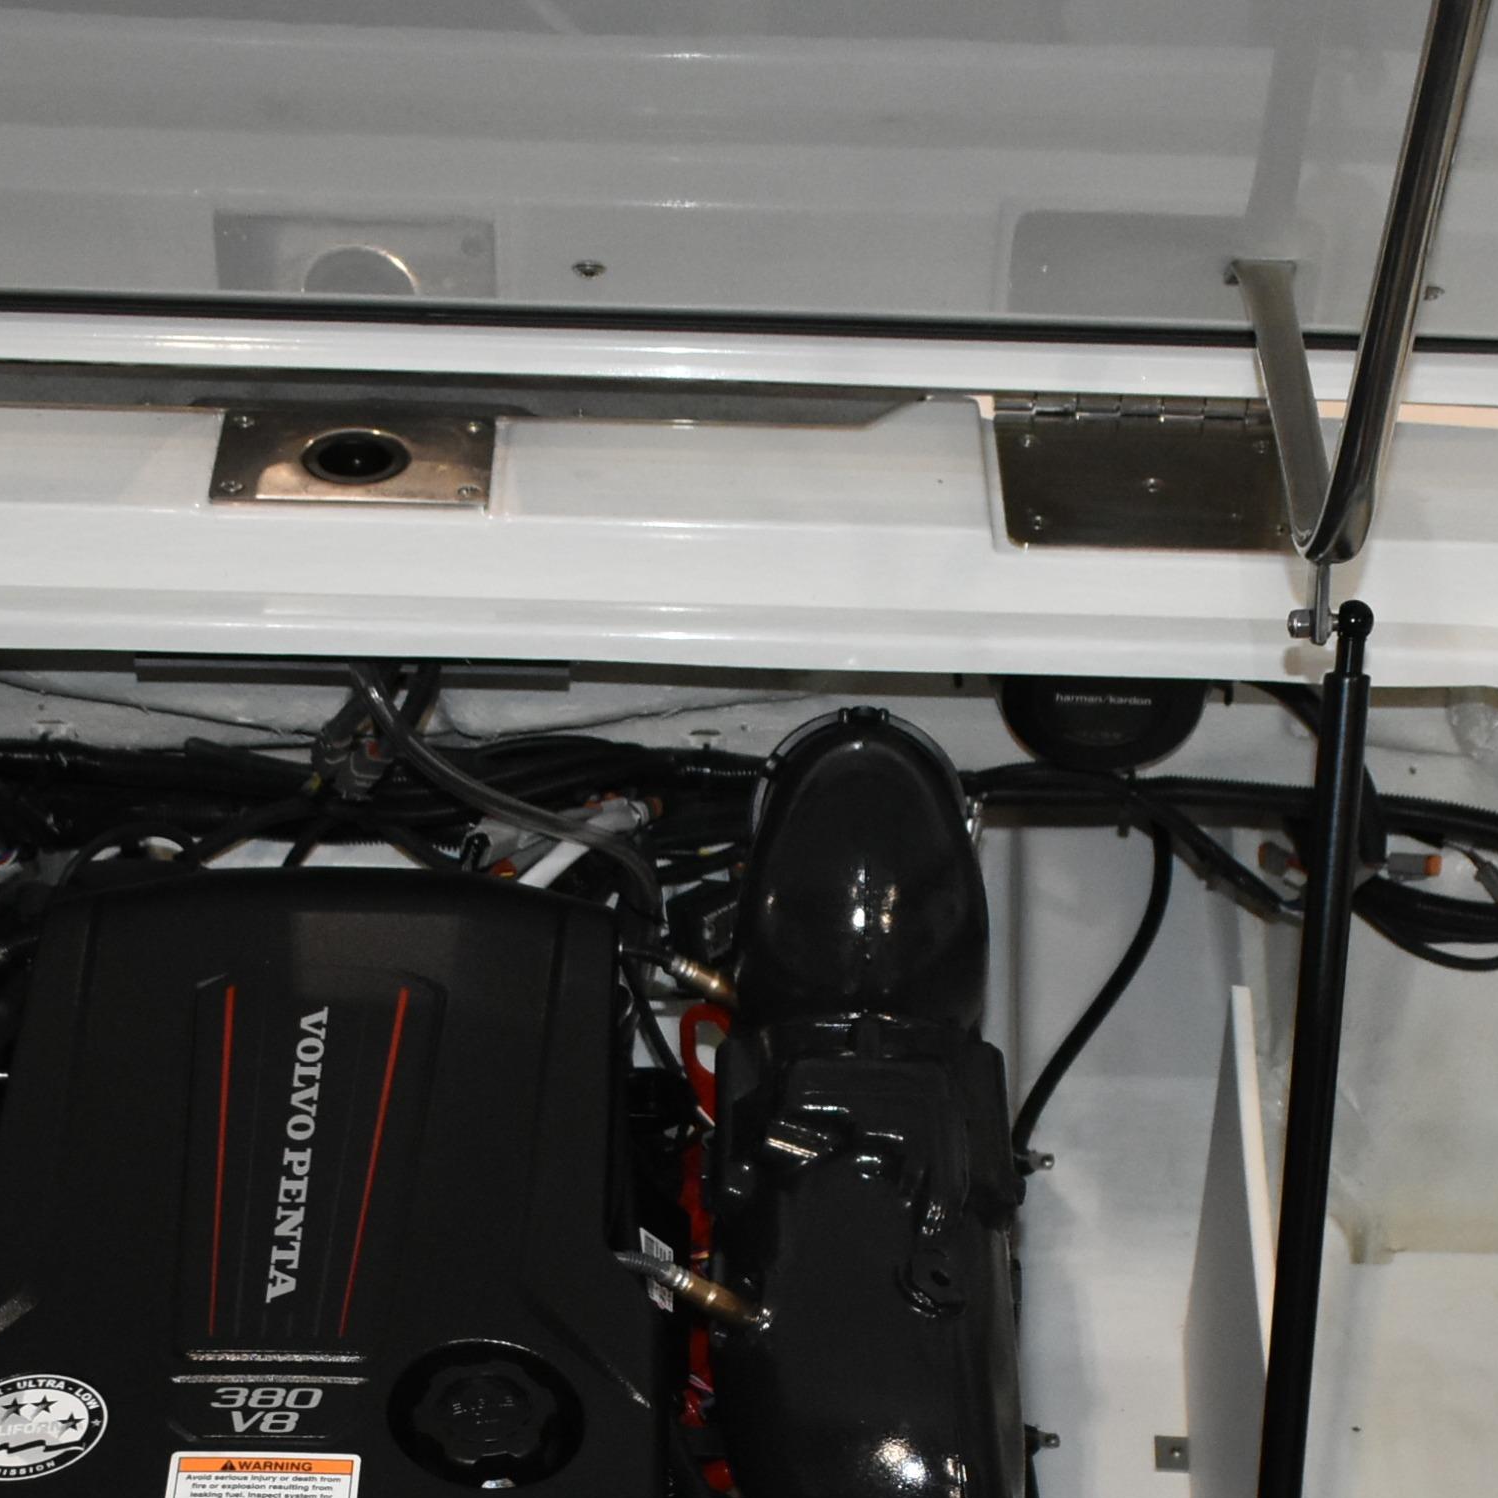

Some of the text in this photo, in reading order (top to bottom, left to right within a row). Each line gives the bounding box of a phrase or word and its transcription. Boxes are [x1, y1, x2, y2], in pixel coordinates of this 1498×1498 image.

[1054, 691, 1152, 707] harman/kardon
[265, 1006, 329, 1303] VOLVO PENTA
[16, 1378, 66, 1391] ULTRA
[73, 1386, 101, 1411] LOW
[210, 1386, 323, 1410] 380
[230, 1410, 300, 1435] V8
[238, 1460, 313, 1472] WARNING
[221, 1483, 266, 1491] explosion
[268, 1483, 309, 1491] resulting
[251, 1475, 277, 1483] injury
[320, 1475, 342, 1483] from
[190, 1491, 223, 1498] leaking
